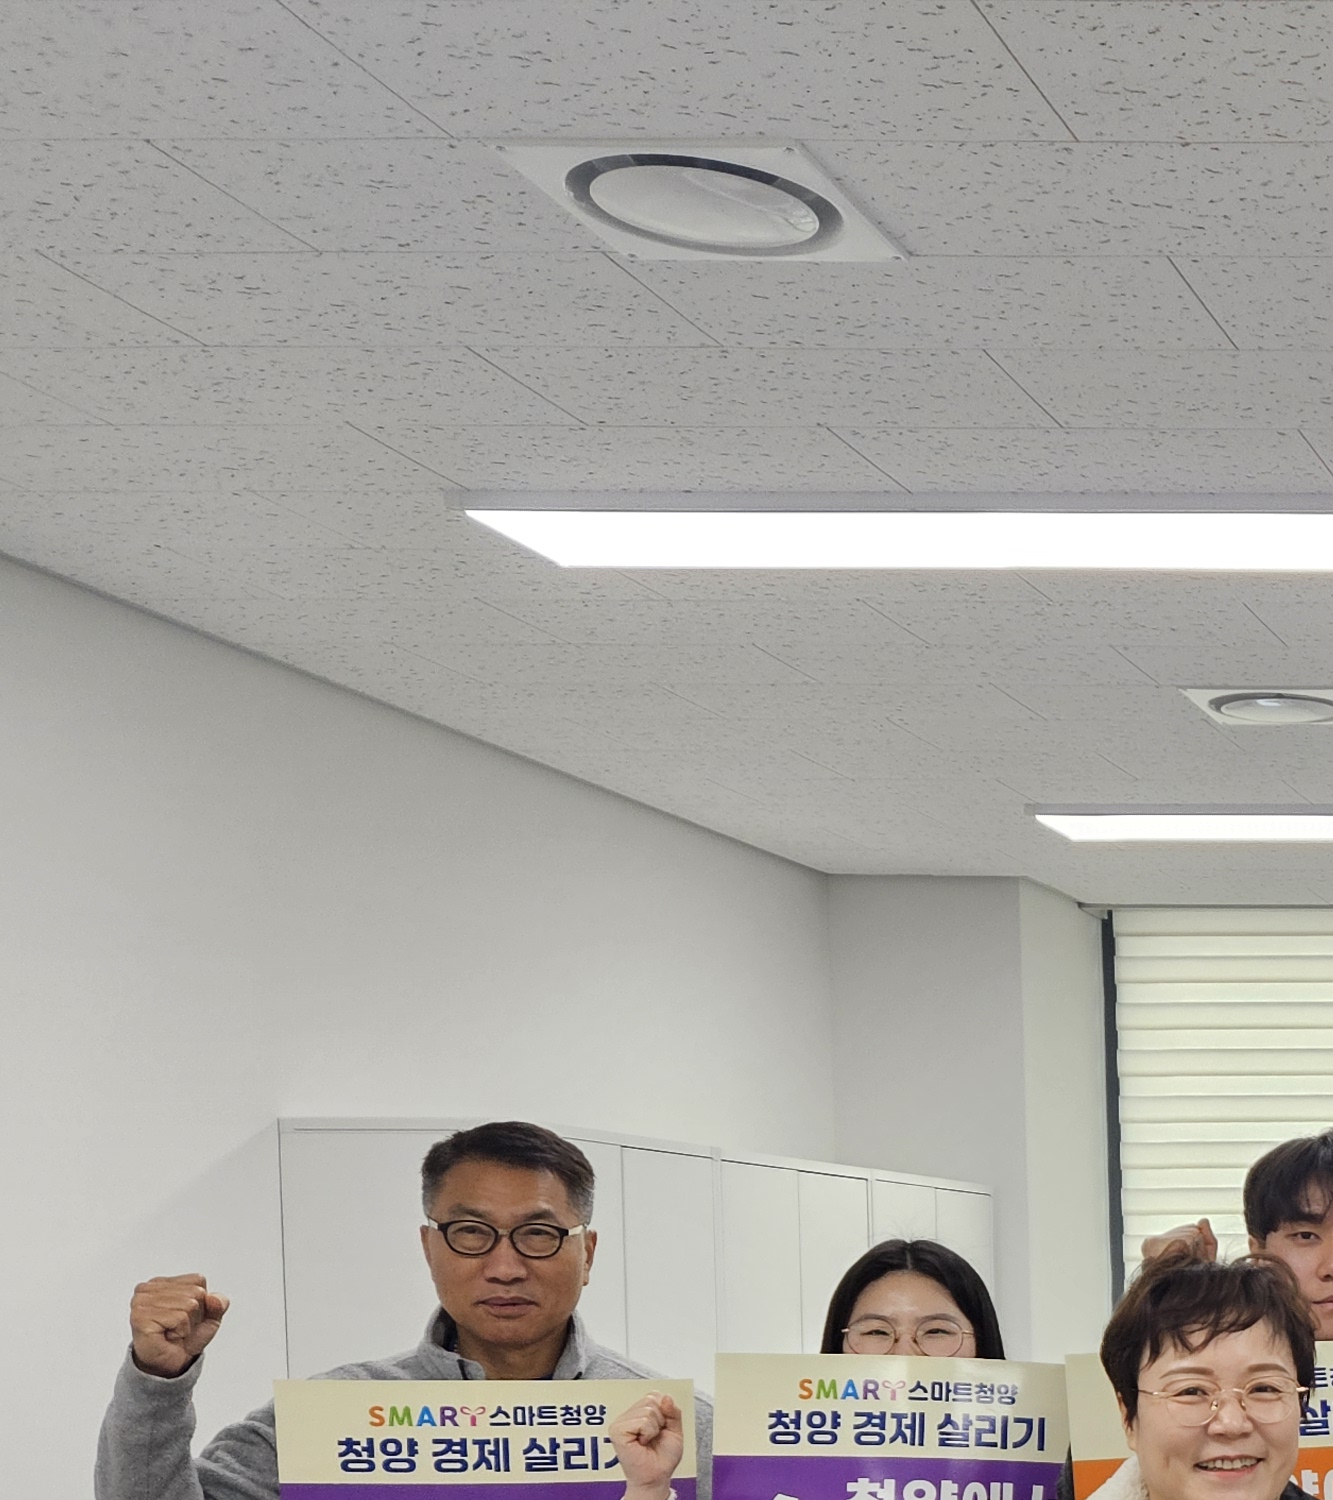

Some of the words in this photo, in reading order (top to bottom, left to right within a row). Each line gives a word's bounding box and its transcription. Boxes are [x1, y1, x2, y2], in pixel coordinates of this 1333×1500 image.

[907, 1381, 1019, 1404] 스마트청양
[489, 1404, 606, 1427] 스마트청양
[767, 1409, 841, 1446] 청양
[853, 1410, 925, 1446] 경제
[937, 1412, 1046, 1451] 살리기
[337, 1437, 419, 1473] 청양
[431, 1437, 510, 1472] 경제
